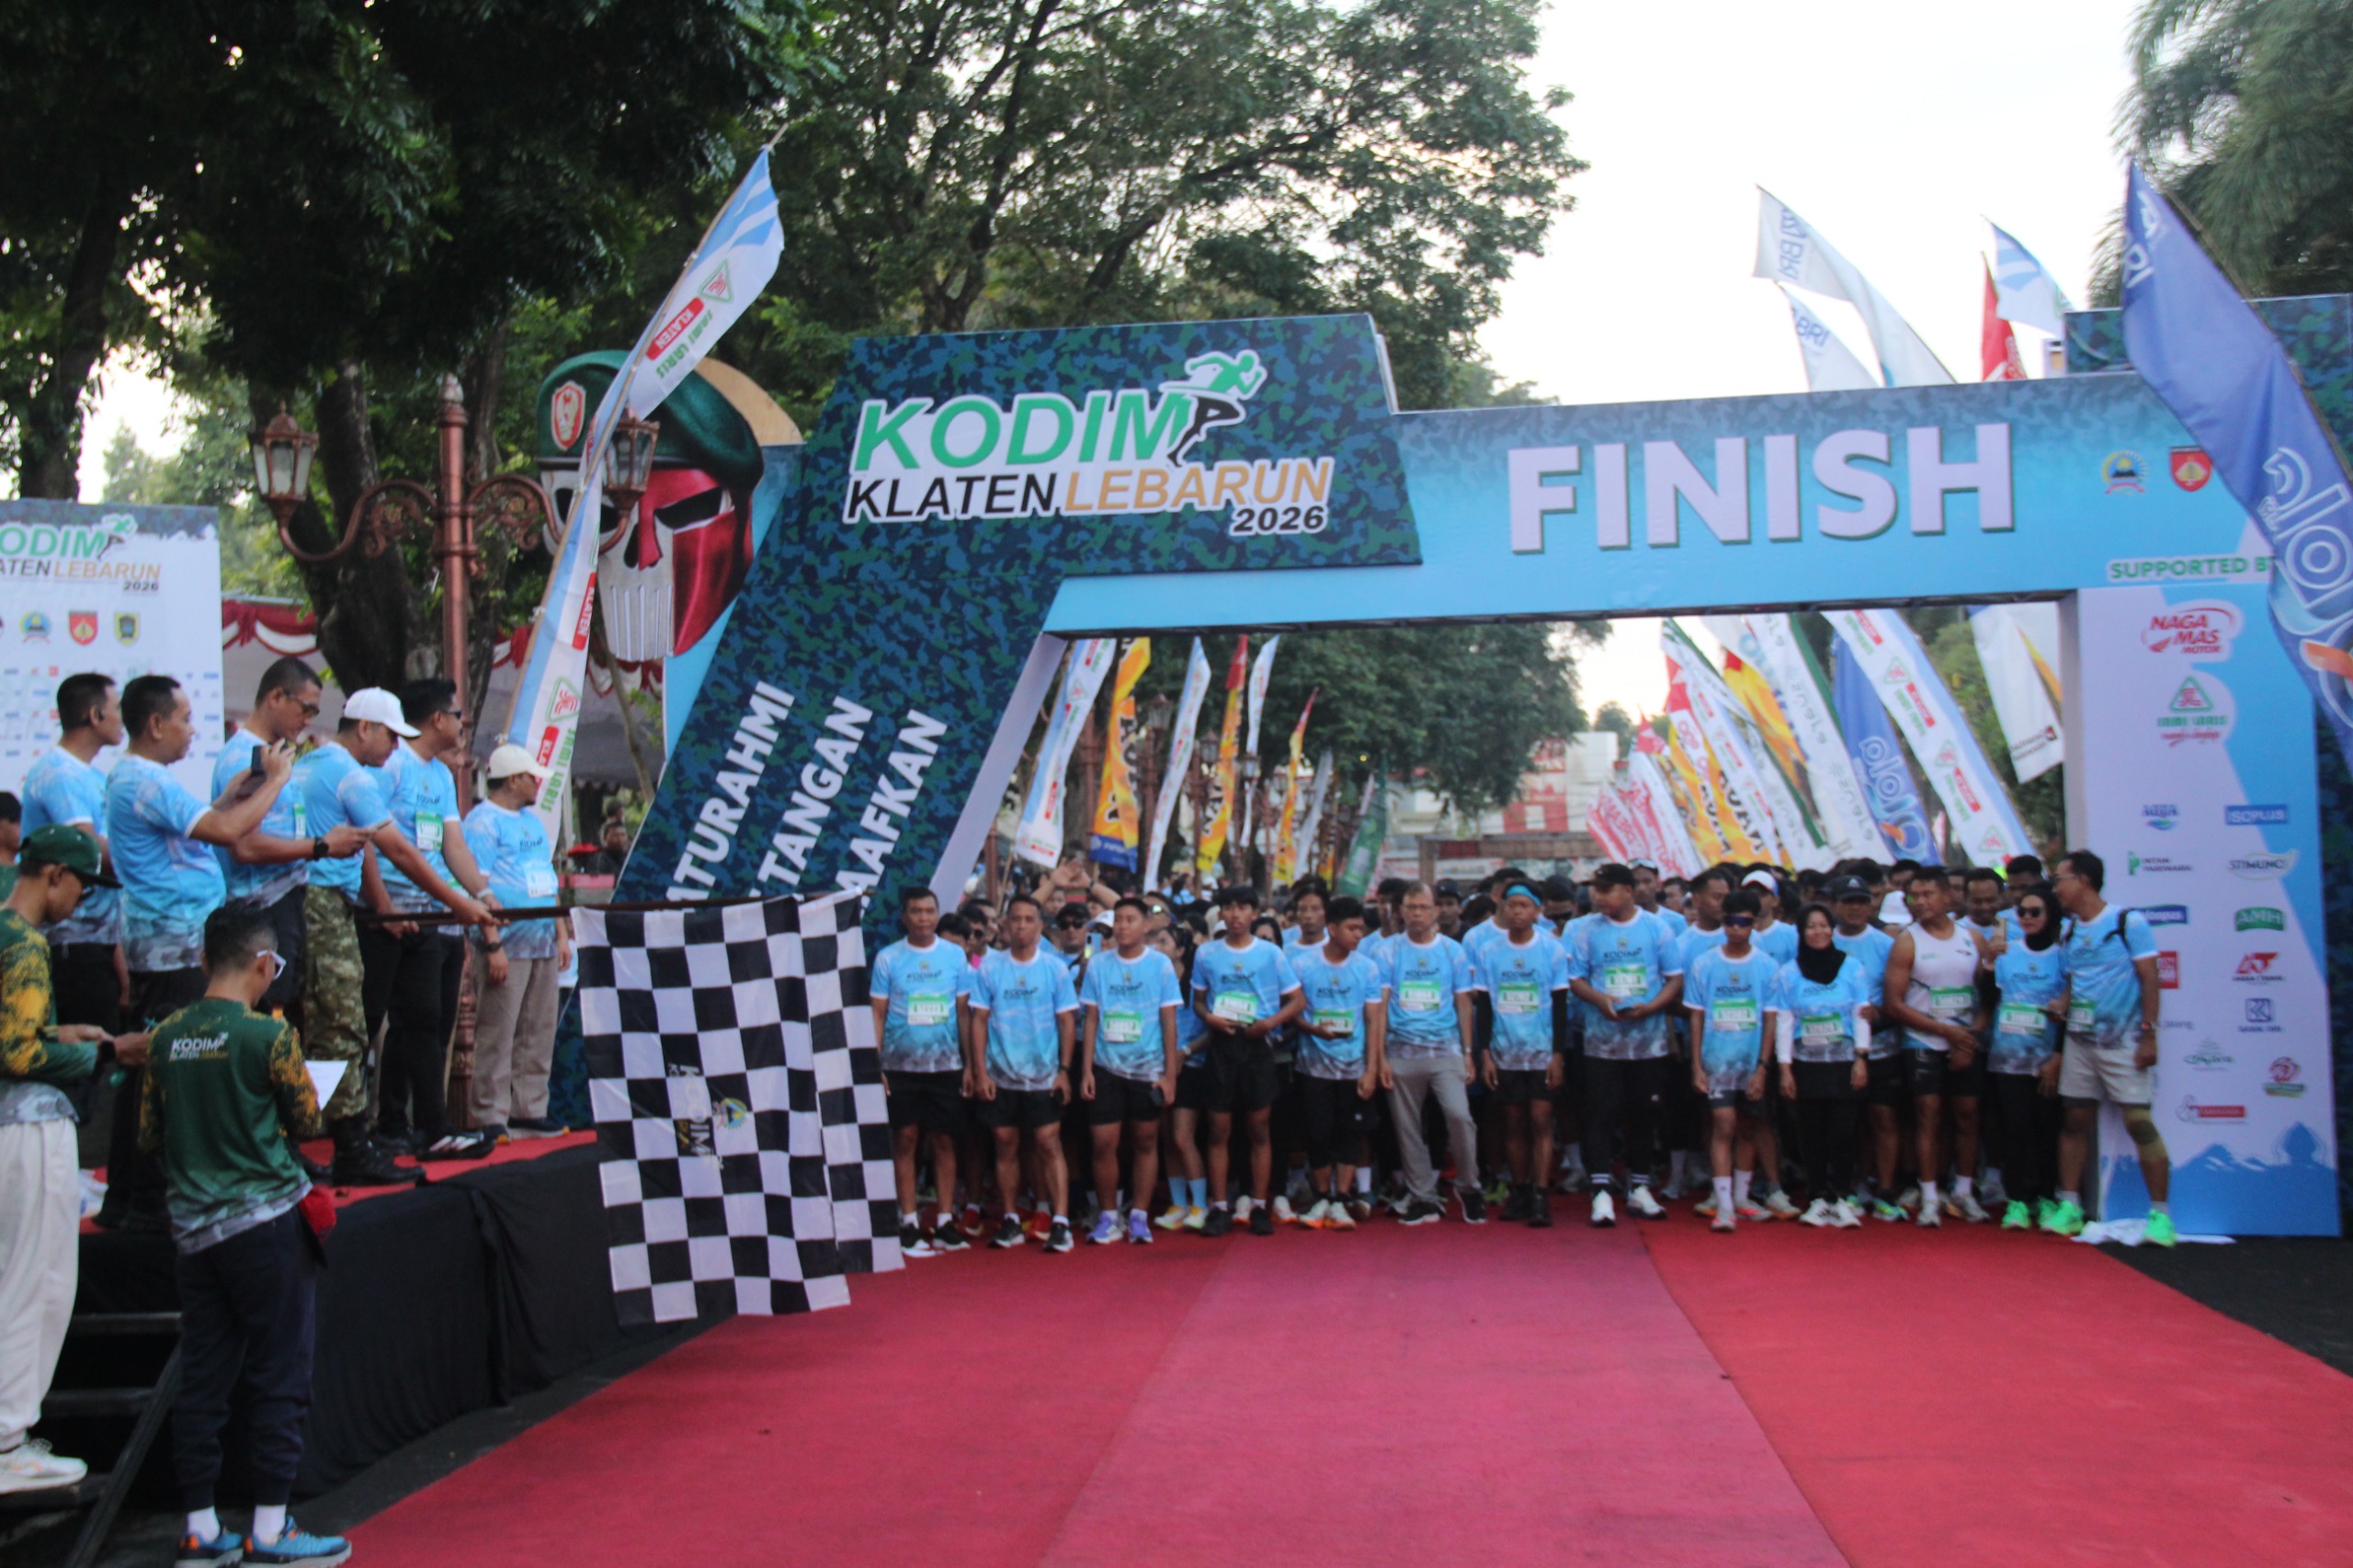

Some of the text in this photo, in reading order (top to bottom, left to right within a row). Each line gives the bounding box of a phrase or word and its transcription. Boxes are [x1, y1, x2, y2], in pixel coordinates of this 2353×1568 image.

[657, 307, 695, 350] KLATEN
[655, 341, 689, 380] LARIS
[853, 390, 1197, 472] KODIM
[847, 460, 1330, 519] KLATEN LEBARUN
[1507, 422, 2014, 553] FINISH
[1235, 506, 1324, 532] 2026
[53, 561, 161, 581] LEBARUN
[2111, 558, 2249, 579] SUPPORTED
[123, 581, 159, 592] 2026
[2150, 615, 2209, 631] NAGA
[2174, 630, 2221, 645] MAS
[2181, 645, 2221, 654] MOTOR
[540, 728, 576, 814] SAMI LARIS
[756, 695, 873, 886] TANGAN
[835, 709, 948, 917] AAFKAN
[2237, 909, 2283, 924] AMH
[171, 1037, 220, 1051] KODIM
